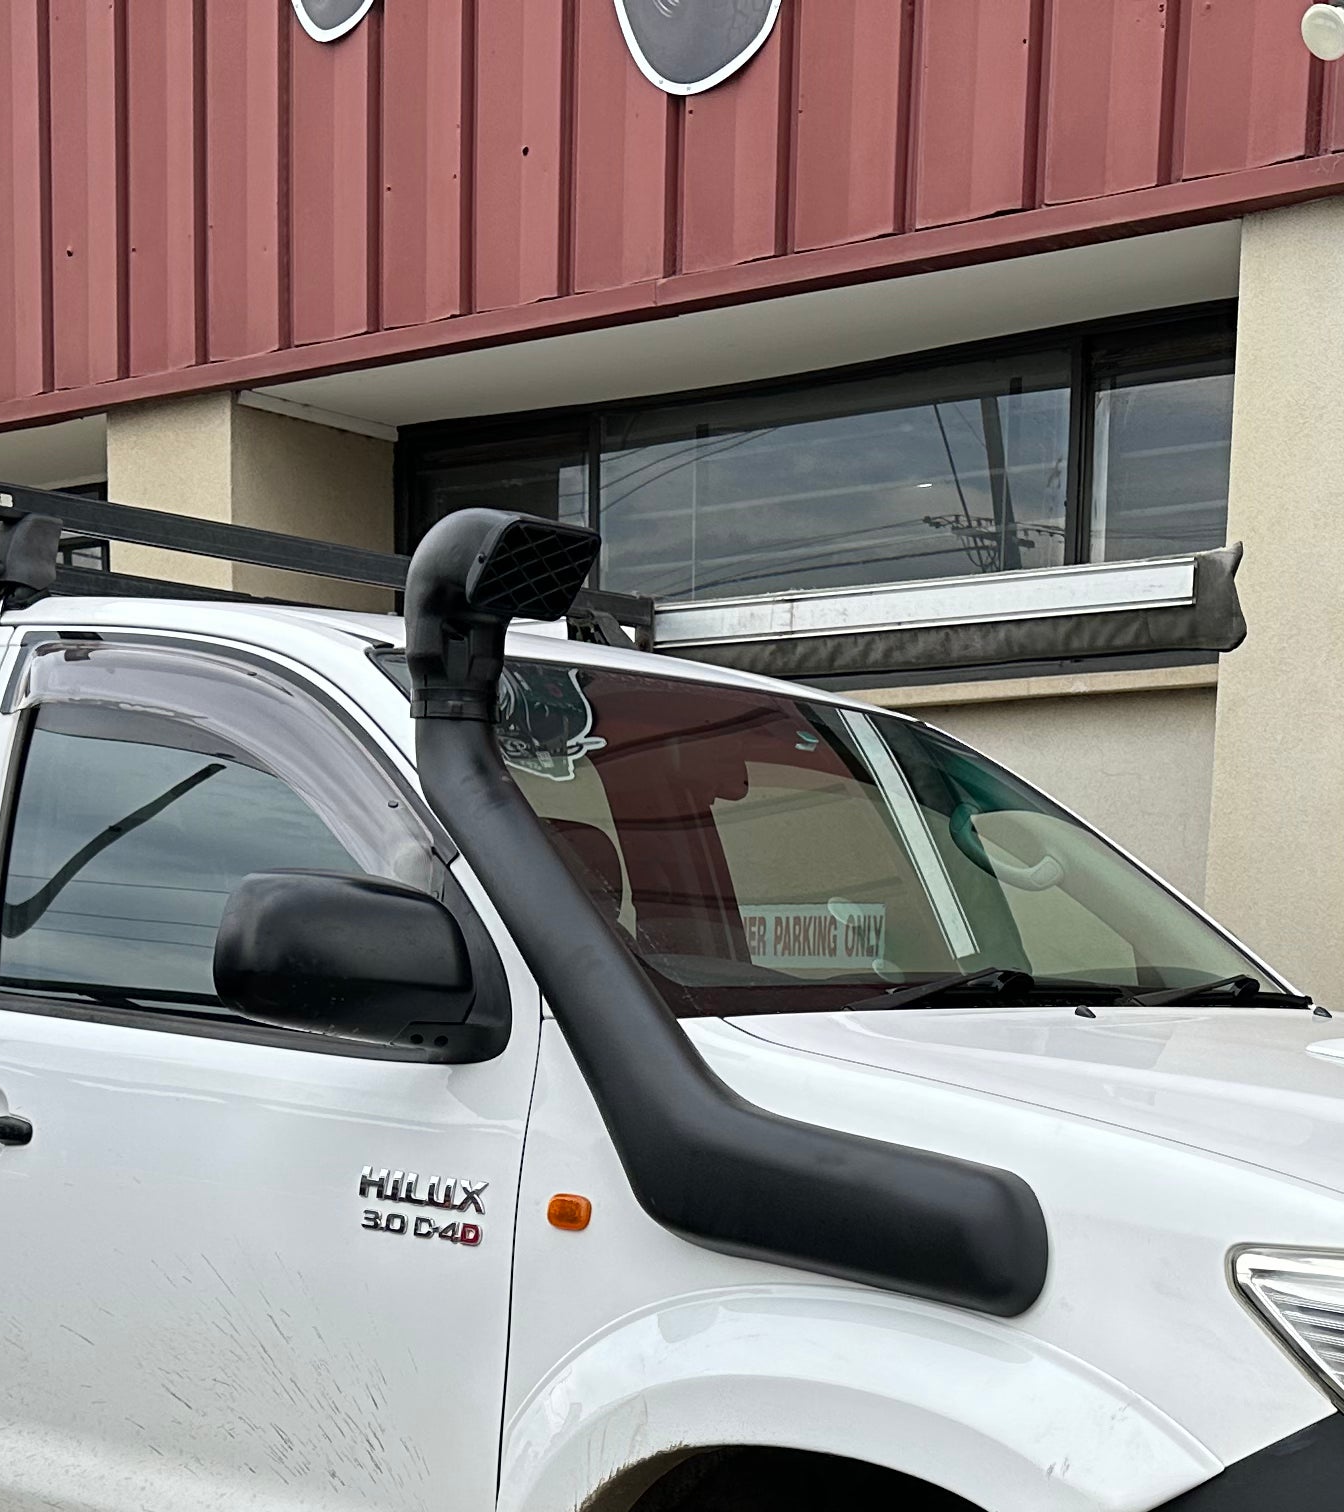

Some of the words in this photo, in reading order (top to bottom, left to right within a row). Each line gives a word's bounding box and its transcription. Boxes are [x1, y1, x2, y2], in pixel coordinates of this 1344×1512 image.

[773, 915, 838, 957] PARKING
[844, 914, 883, 957] ONLY
[359, 1166, 489, 1214] HILUX
[361, 1209, 408, 1235] 3.0
[413, 1216, 483, 1247] D-4D
